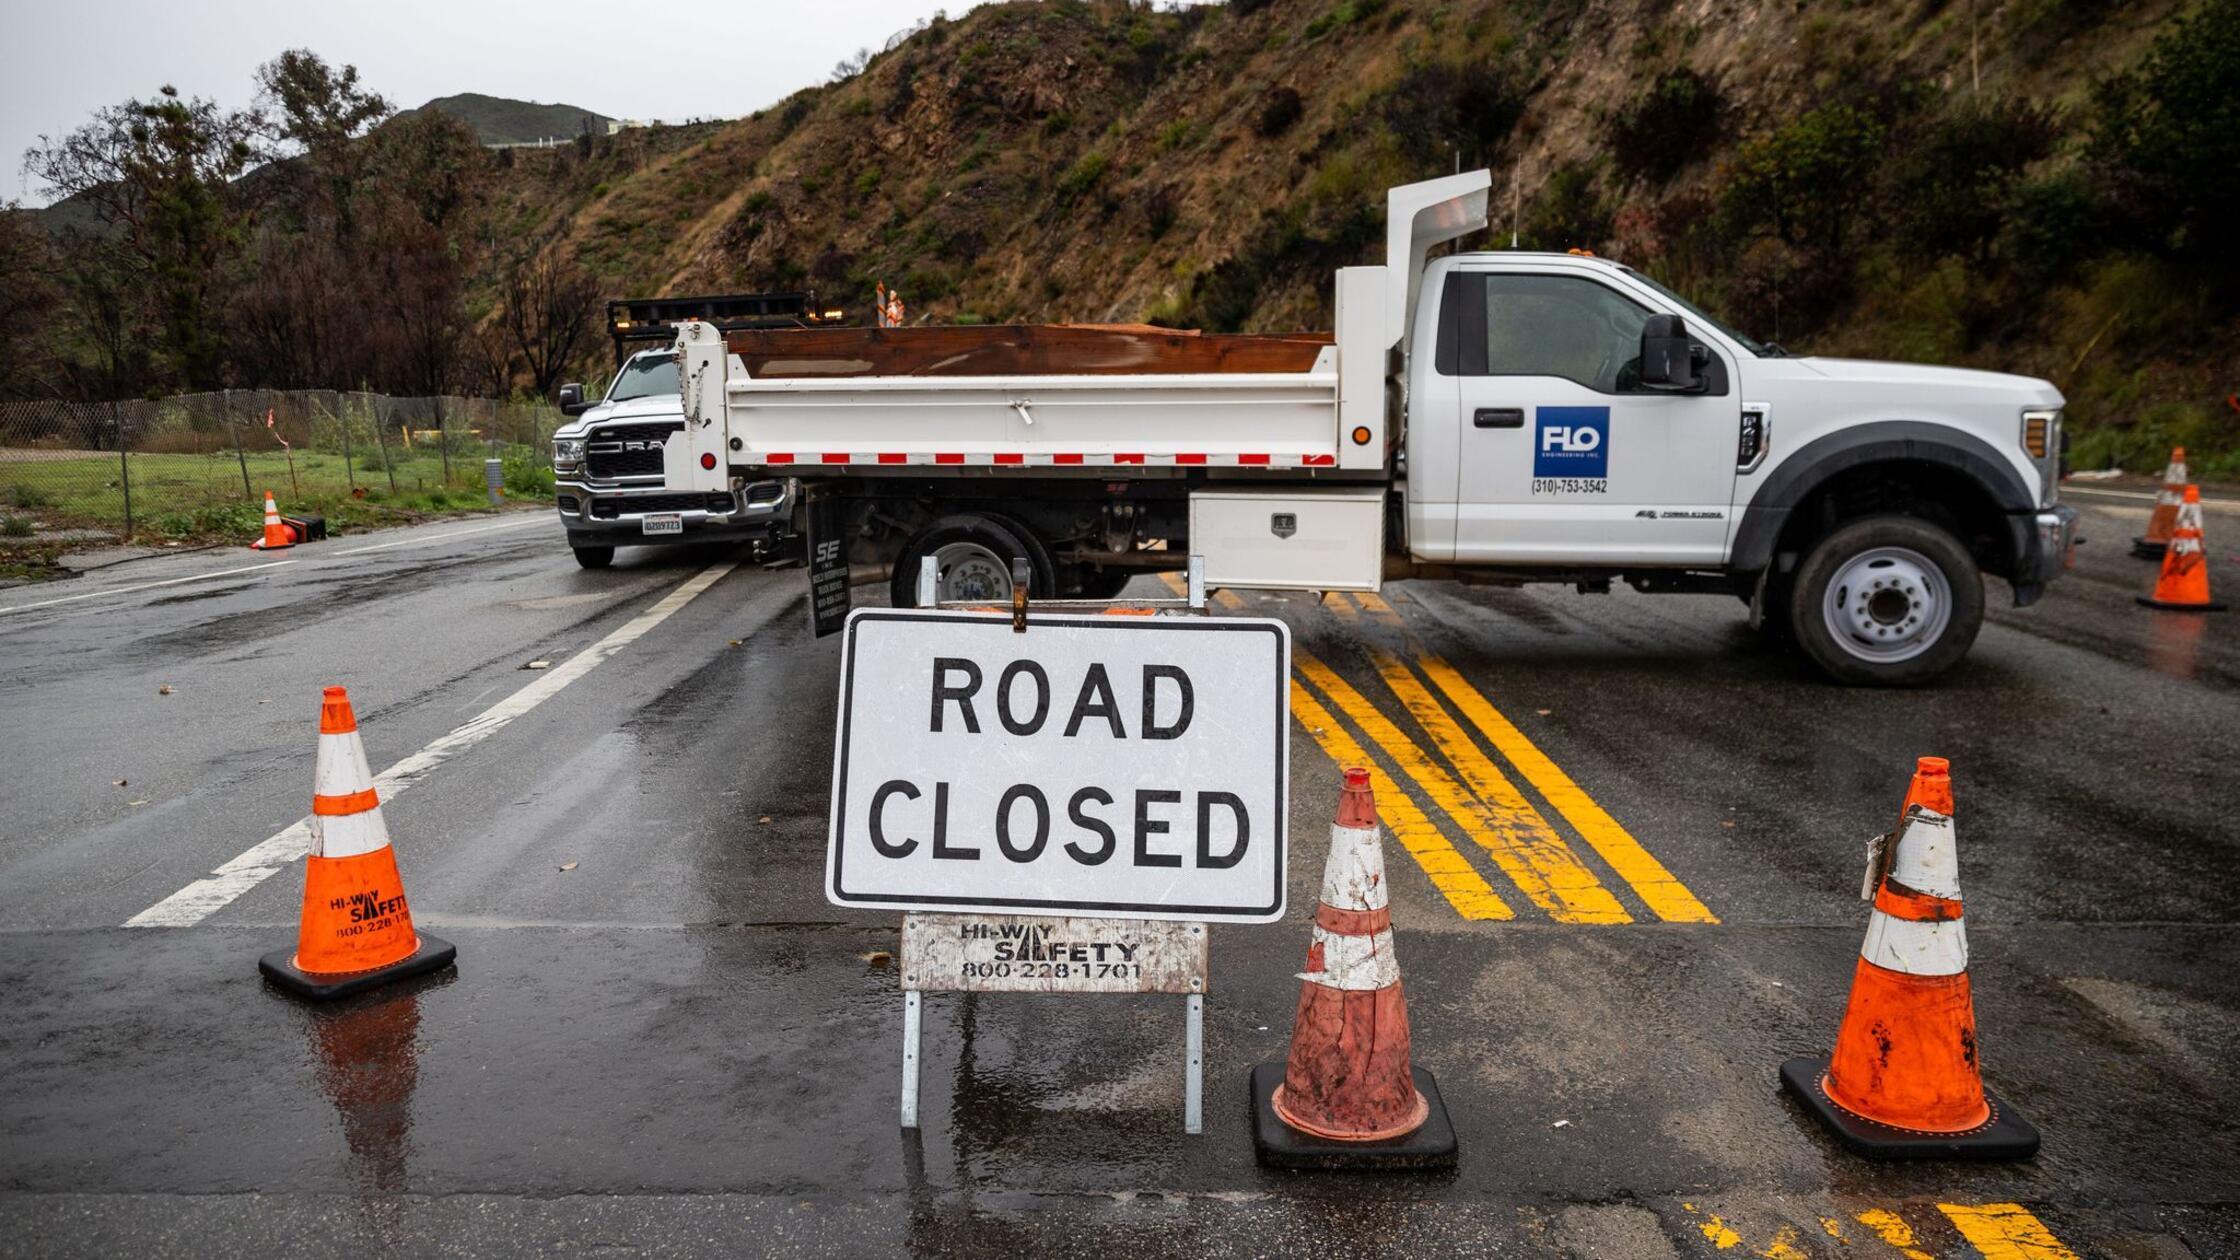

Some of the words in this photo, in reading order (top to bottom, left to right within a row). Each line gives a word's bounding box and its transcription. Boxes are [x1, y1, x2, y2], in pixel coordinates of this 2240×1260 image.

[1542, 426, 1601, 452] FLO
[1532, 479, 1608, 496] (310)-753-3542
[816, 540, 841, 563] SE
[930, 657, 1195, 740] ROAD
[868, 779, 1251, 869] CLOSED
[994, 940, 1141, 962] SAFETY
